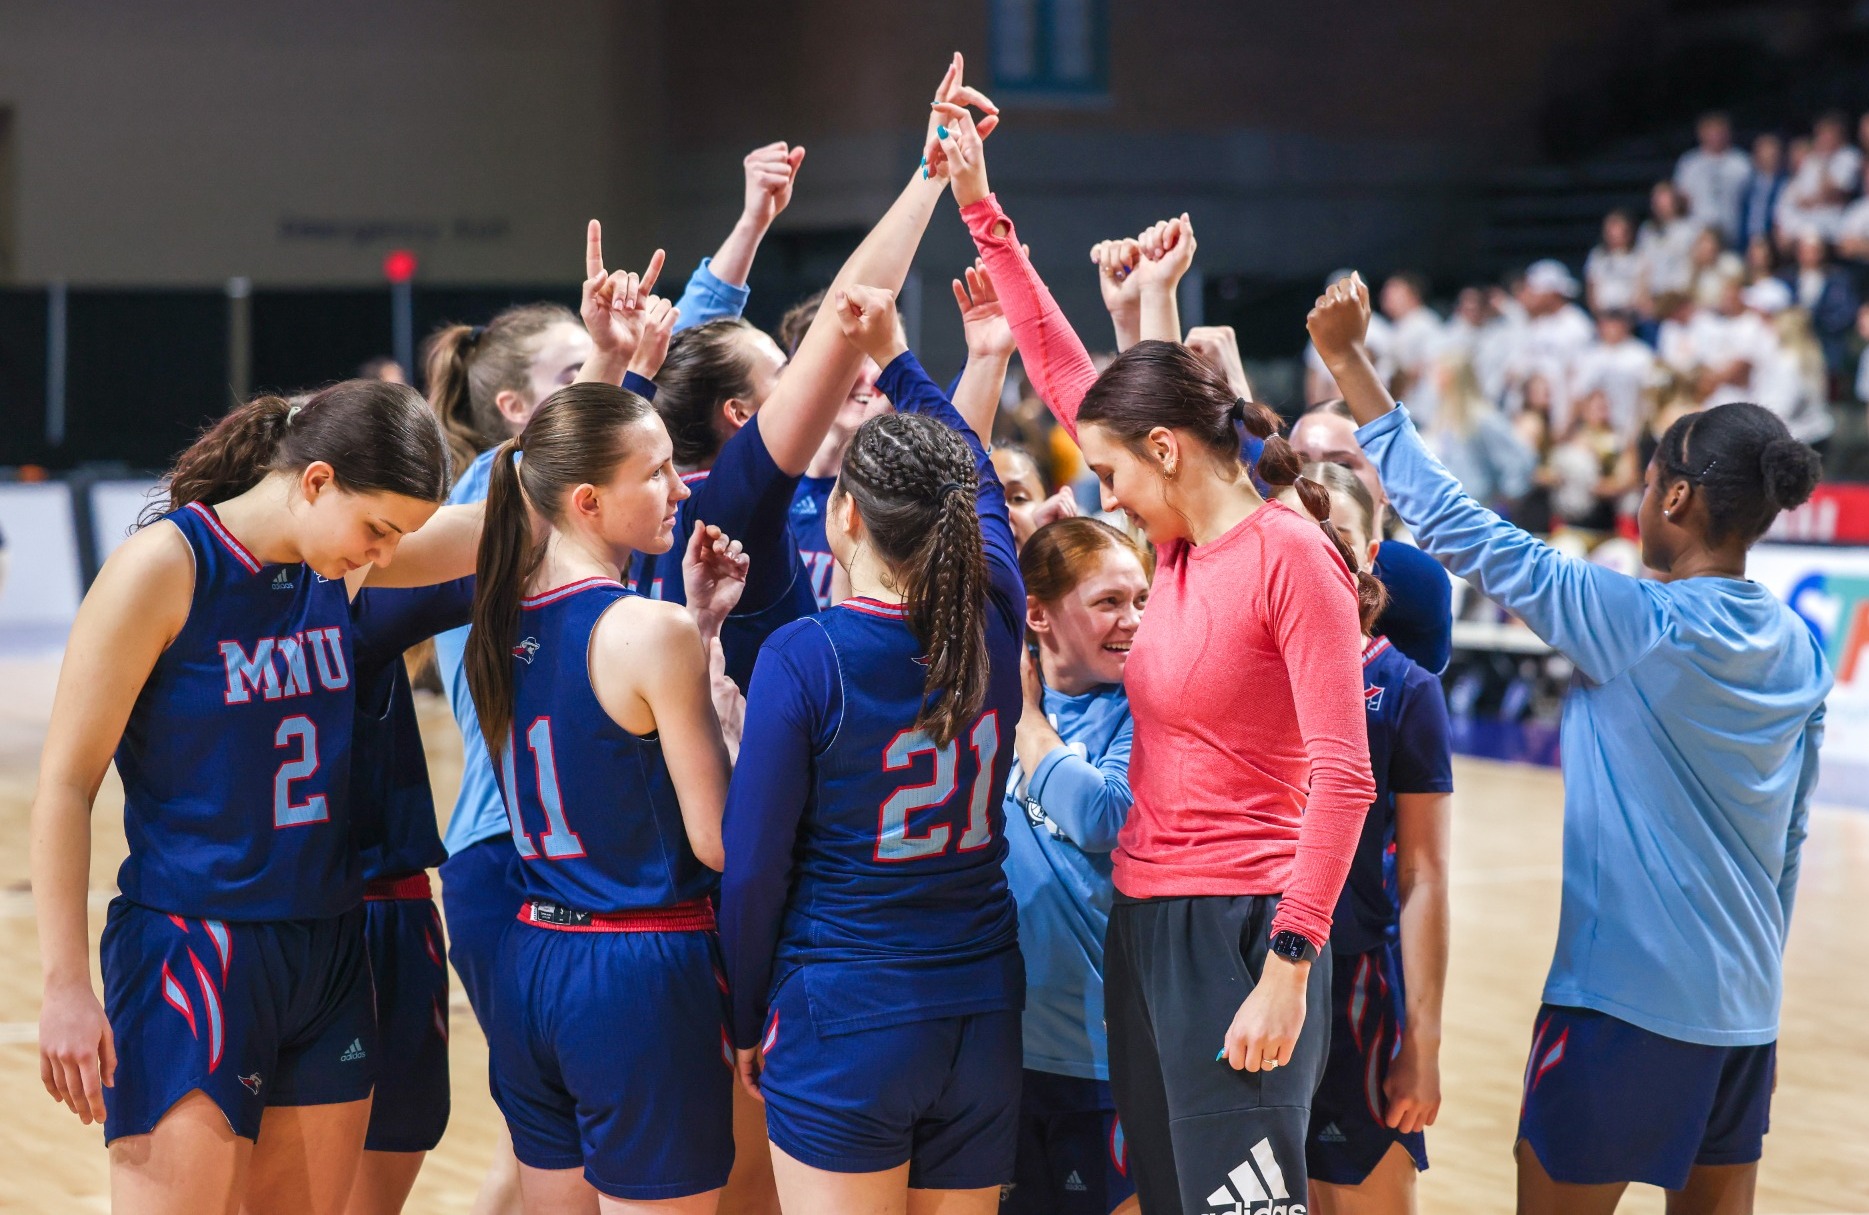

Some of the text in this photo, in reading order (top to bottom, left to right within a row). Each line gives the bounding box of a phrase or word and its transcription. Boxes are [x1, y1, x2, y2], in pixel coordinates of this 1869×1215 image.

[218, 626, 350, 705] MNU
[274, 713, 331, 830] 2
[499, 715, 588, 860] 11
[873, 708, 1000, 863] 21
[340, 1051, 367, 1061] adidas
